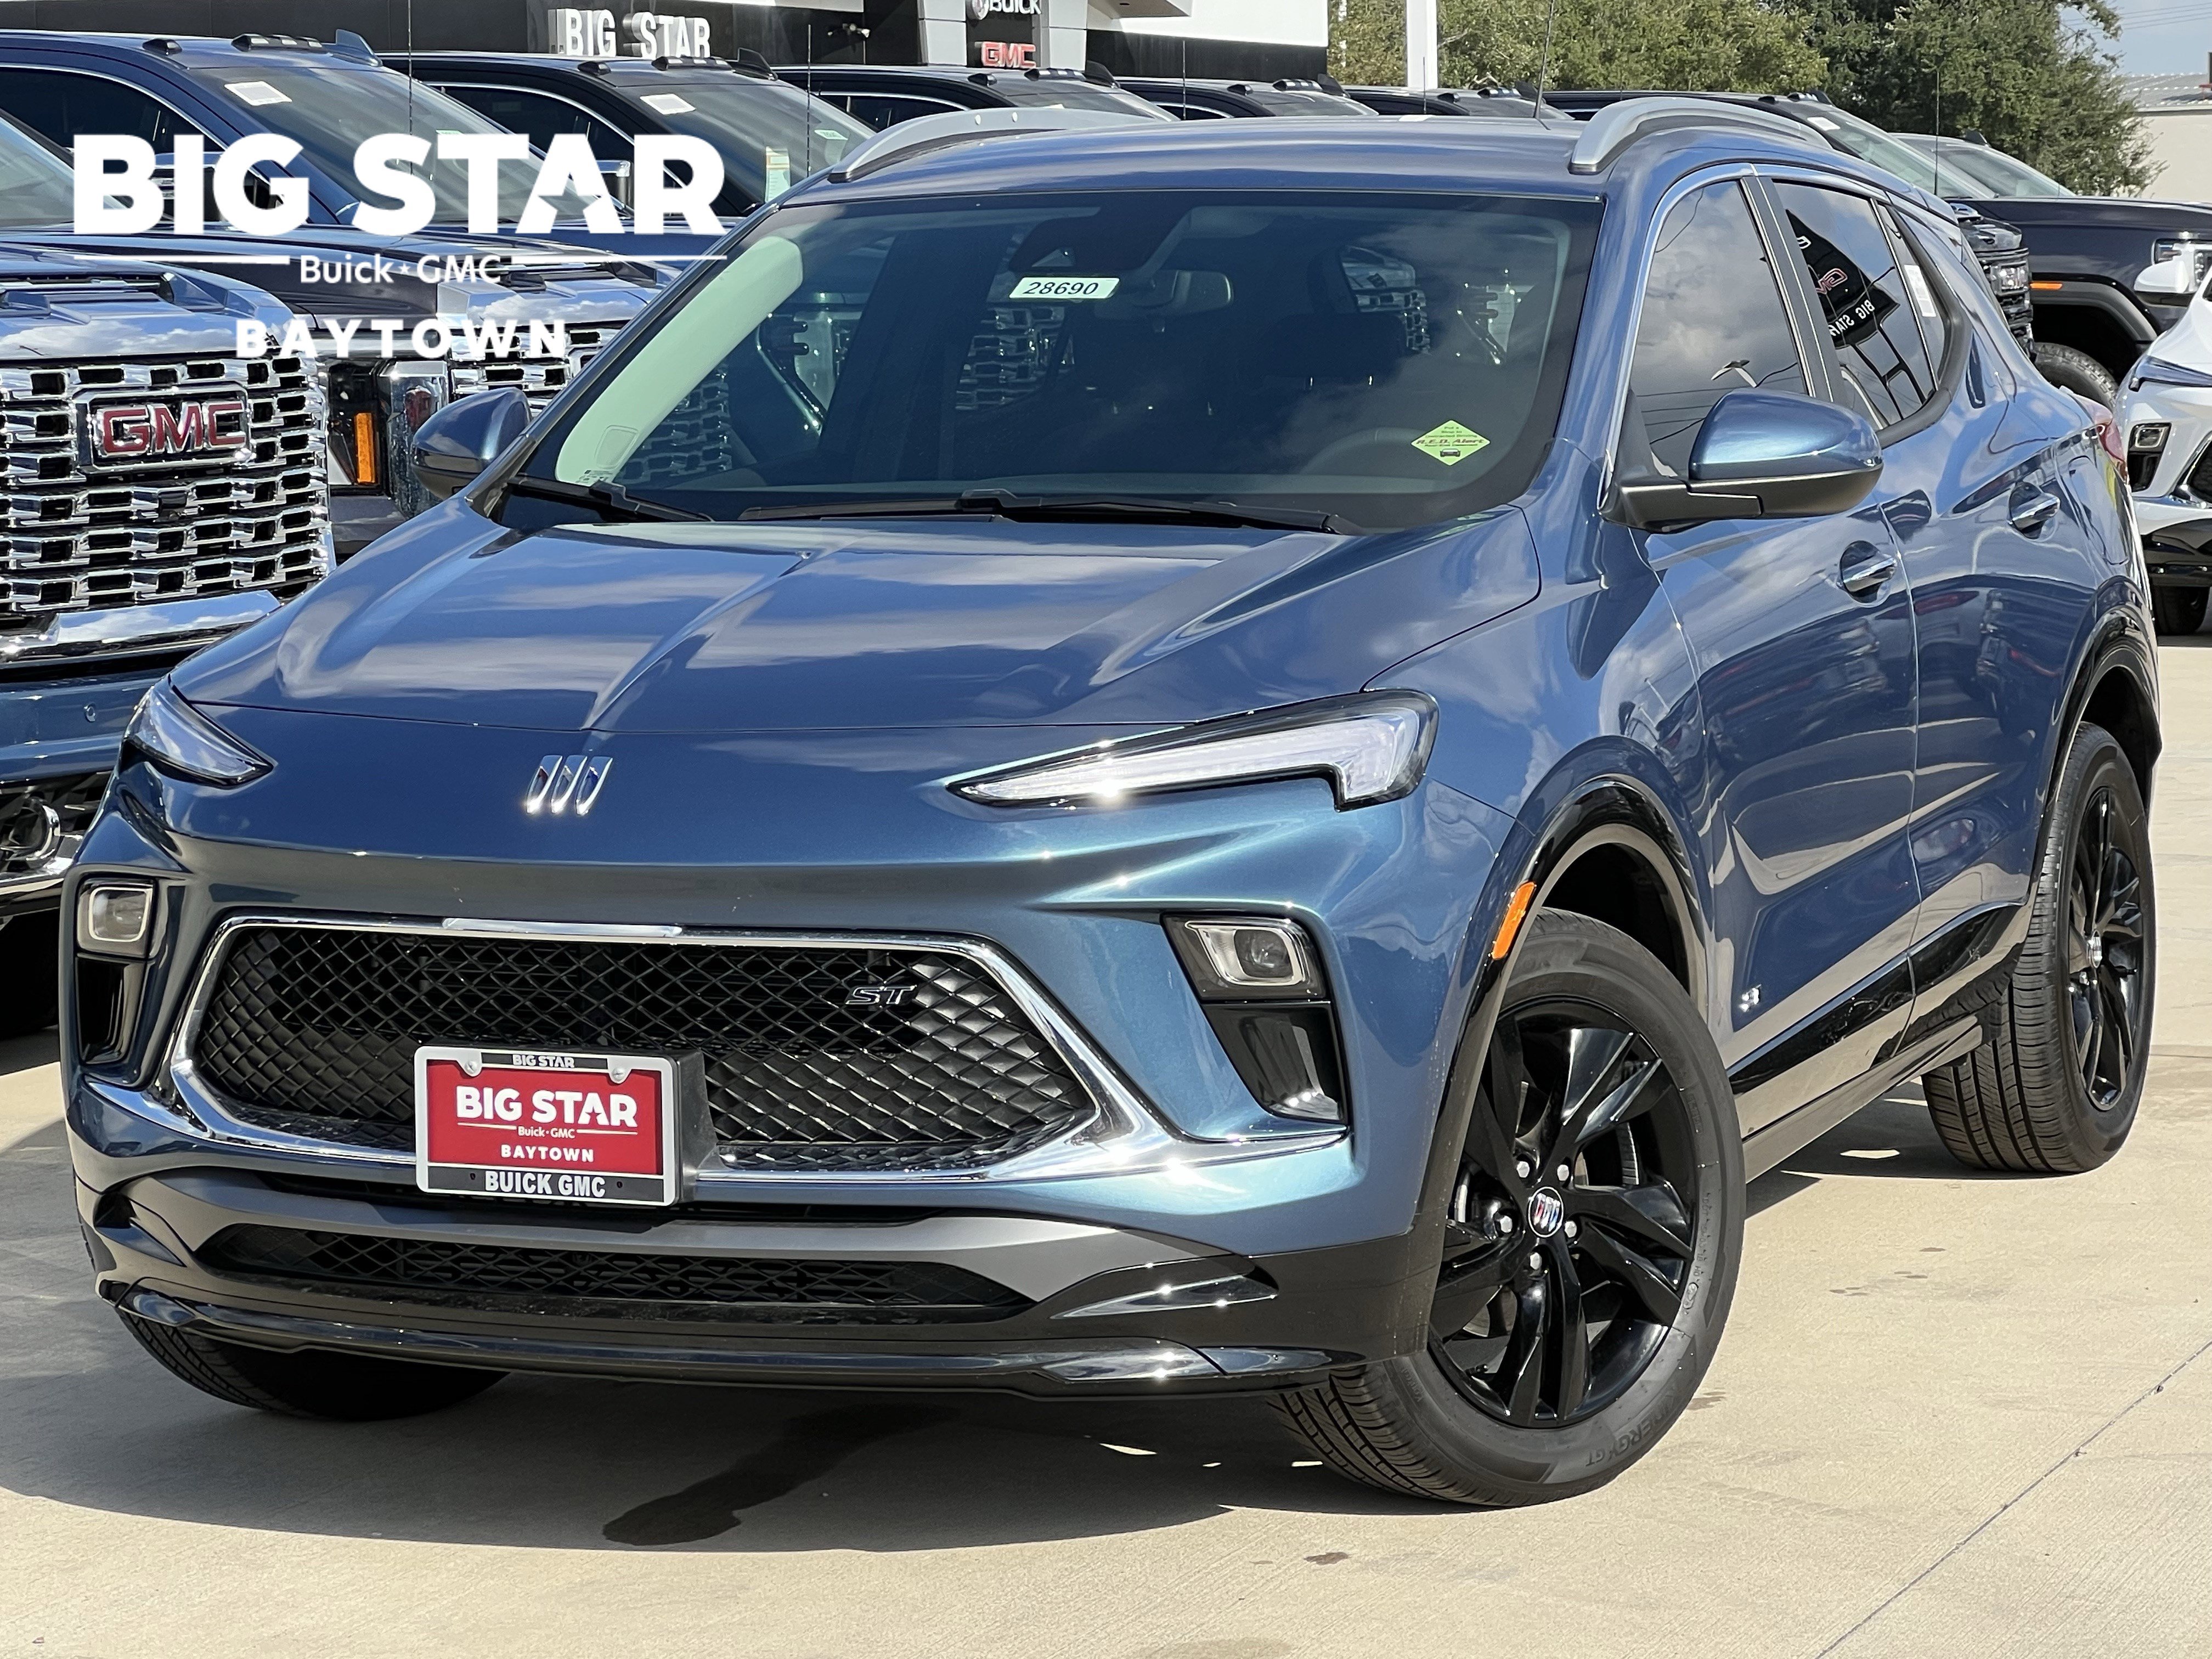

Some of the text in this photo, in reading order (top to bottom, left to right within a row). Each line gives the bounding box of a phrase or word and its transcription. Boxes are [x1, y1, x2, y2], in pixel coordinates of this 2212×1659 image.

[558, 8, 710, 60] BIG STAR
[981, 41, 1036, 69] GMC
[1022, 281, 1099, 295] 28690
[96, 401, 246, 456] GMC
[845, 985, 917, 1005] ST
[512, 1054, 575, 1068] BIG STAR
[456, 1086, 637, 1128] BIG STAR
[518, 1126, 575, 1138] Buick GMC
[501, 1144, 594, 1163] BAYTOWN
[485, 1171, 606, 1198] BUICK GMC
[1607, 1386, 1683, 1462] KNERGY
